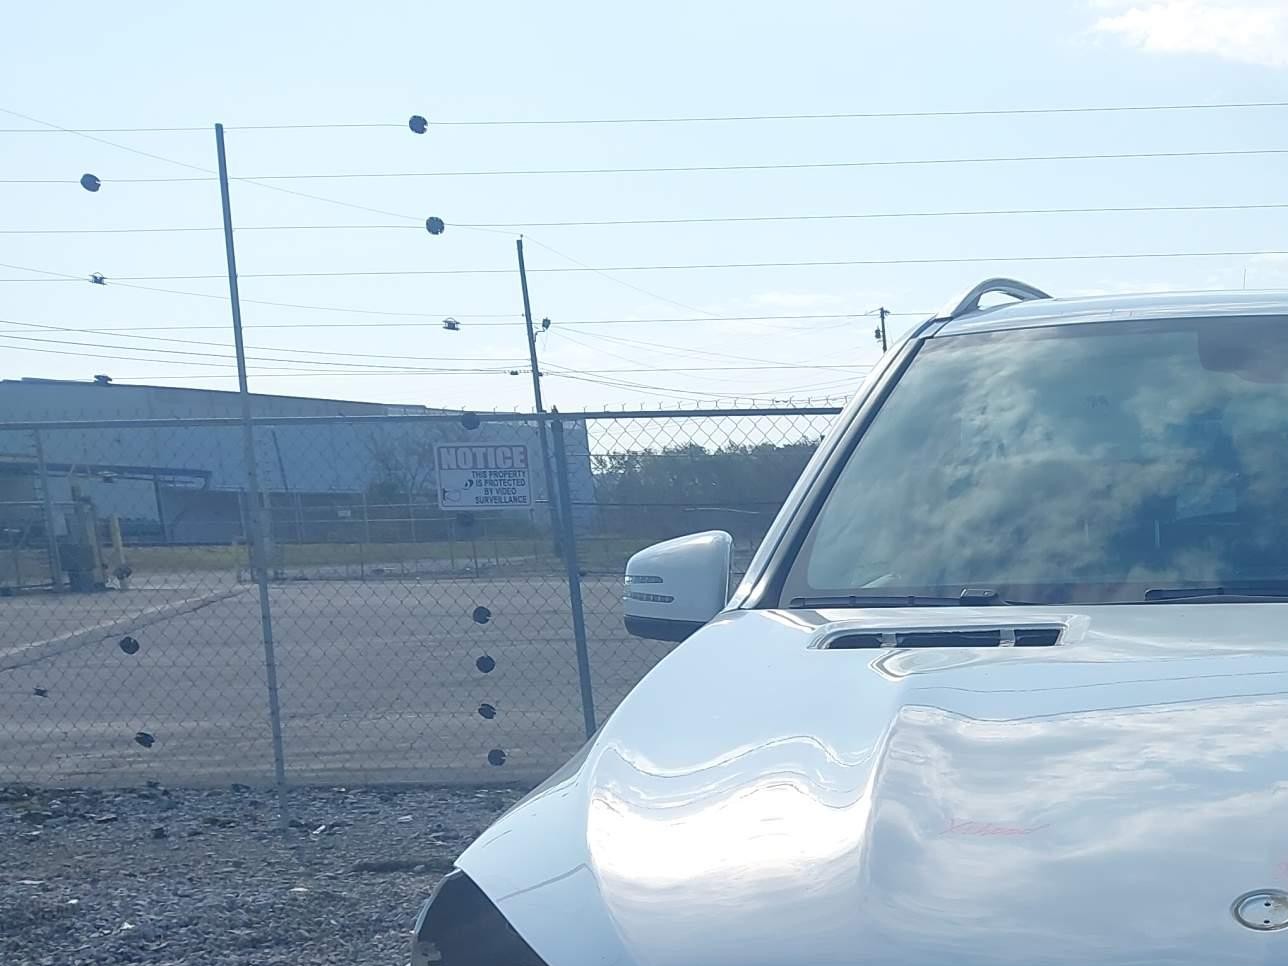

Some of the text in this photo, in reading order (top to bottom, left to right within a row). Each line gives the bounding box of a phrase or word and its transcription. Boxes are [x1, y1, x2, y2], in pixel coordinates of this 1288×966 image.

[440, 447, 528, 470] NOTICE
[472, 471, 526, 479] THIS PROPERTY
[475, 479, 526, 487] IS PROTECTED
[484, 488, 517, 496] BY VIDEO
[475, 495, 527, 504] SURVEILLANCE
